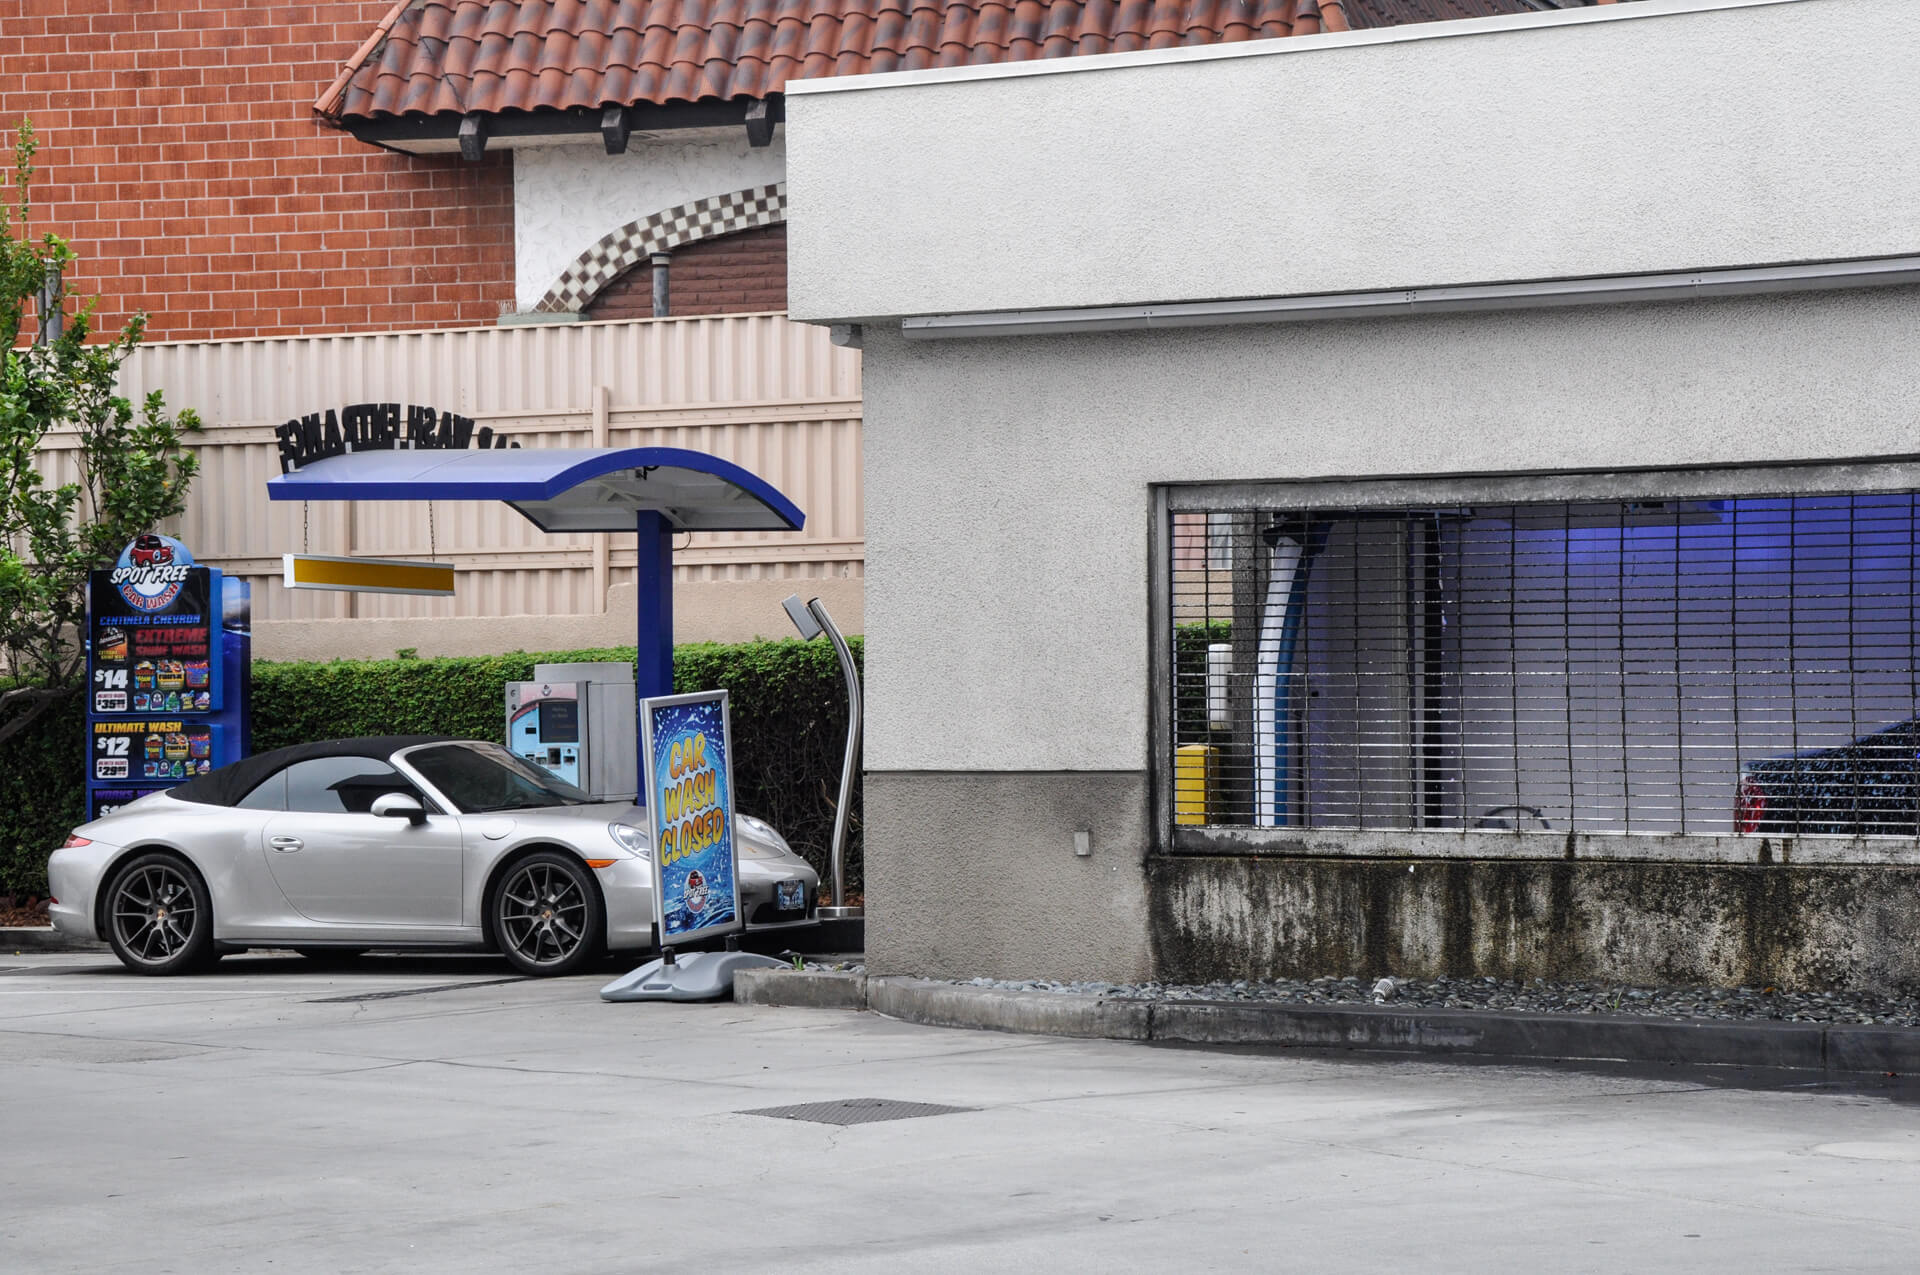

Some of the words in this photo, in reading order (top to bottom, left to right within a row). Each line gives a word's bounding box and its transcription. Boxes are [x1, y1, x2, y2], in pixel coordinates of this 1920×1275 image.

[110, 566, 150, 584] SPOT
[151, 565, 191, 583] FREE
[122, 584, 144, 608] CAR
[146, 582, 180, 610] WASH
[153, 614, 200, 625] CHEVRON
[136, 628, 208, 643] EXTREME
[172, 644, 208, 656] WASH
[95, 669, 129, 689] $14
[94, 722, 146, 733] ULTIMATE
[148, 721, 182, 733] WASH
[97, 736, 130, 756] $12
[669, 732, 706, 779] CAR
[664, 768, 716, 824] WASH
[660, 807, 725, 867] CLOSED
